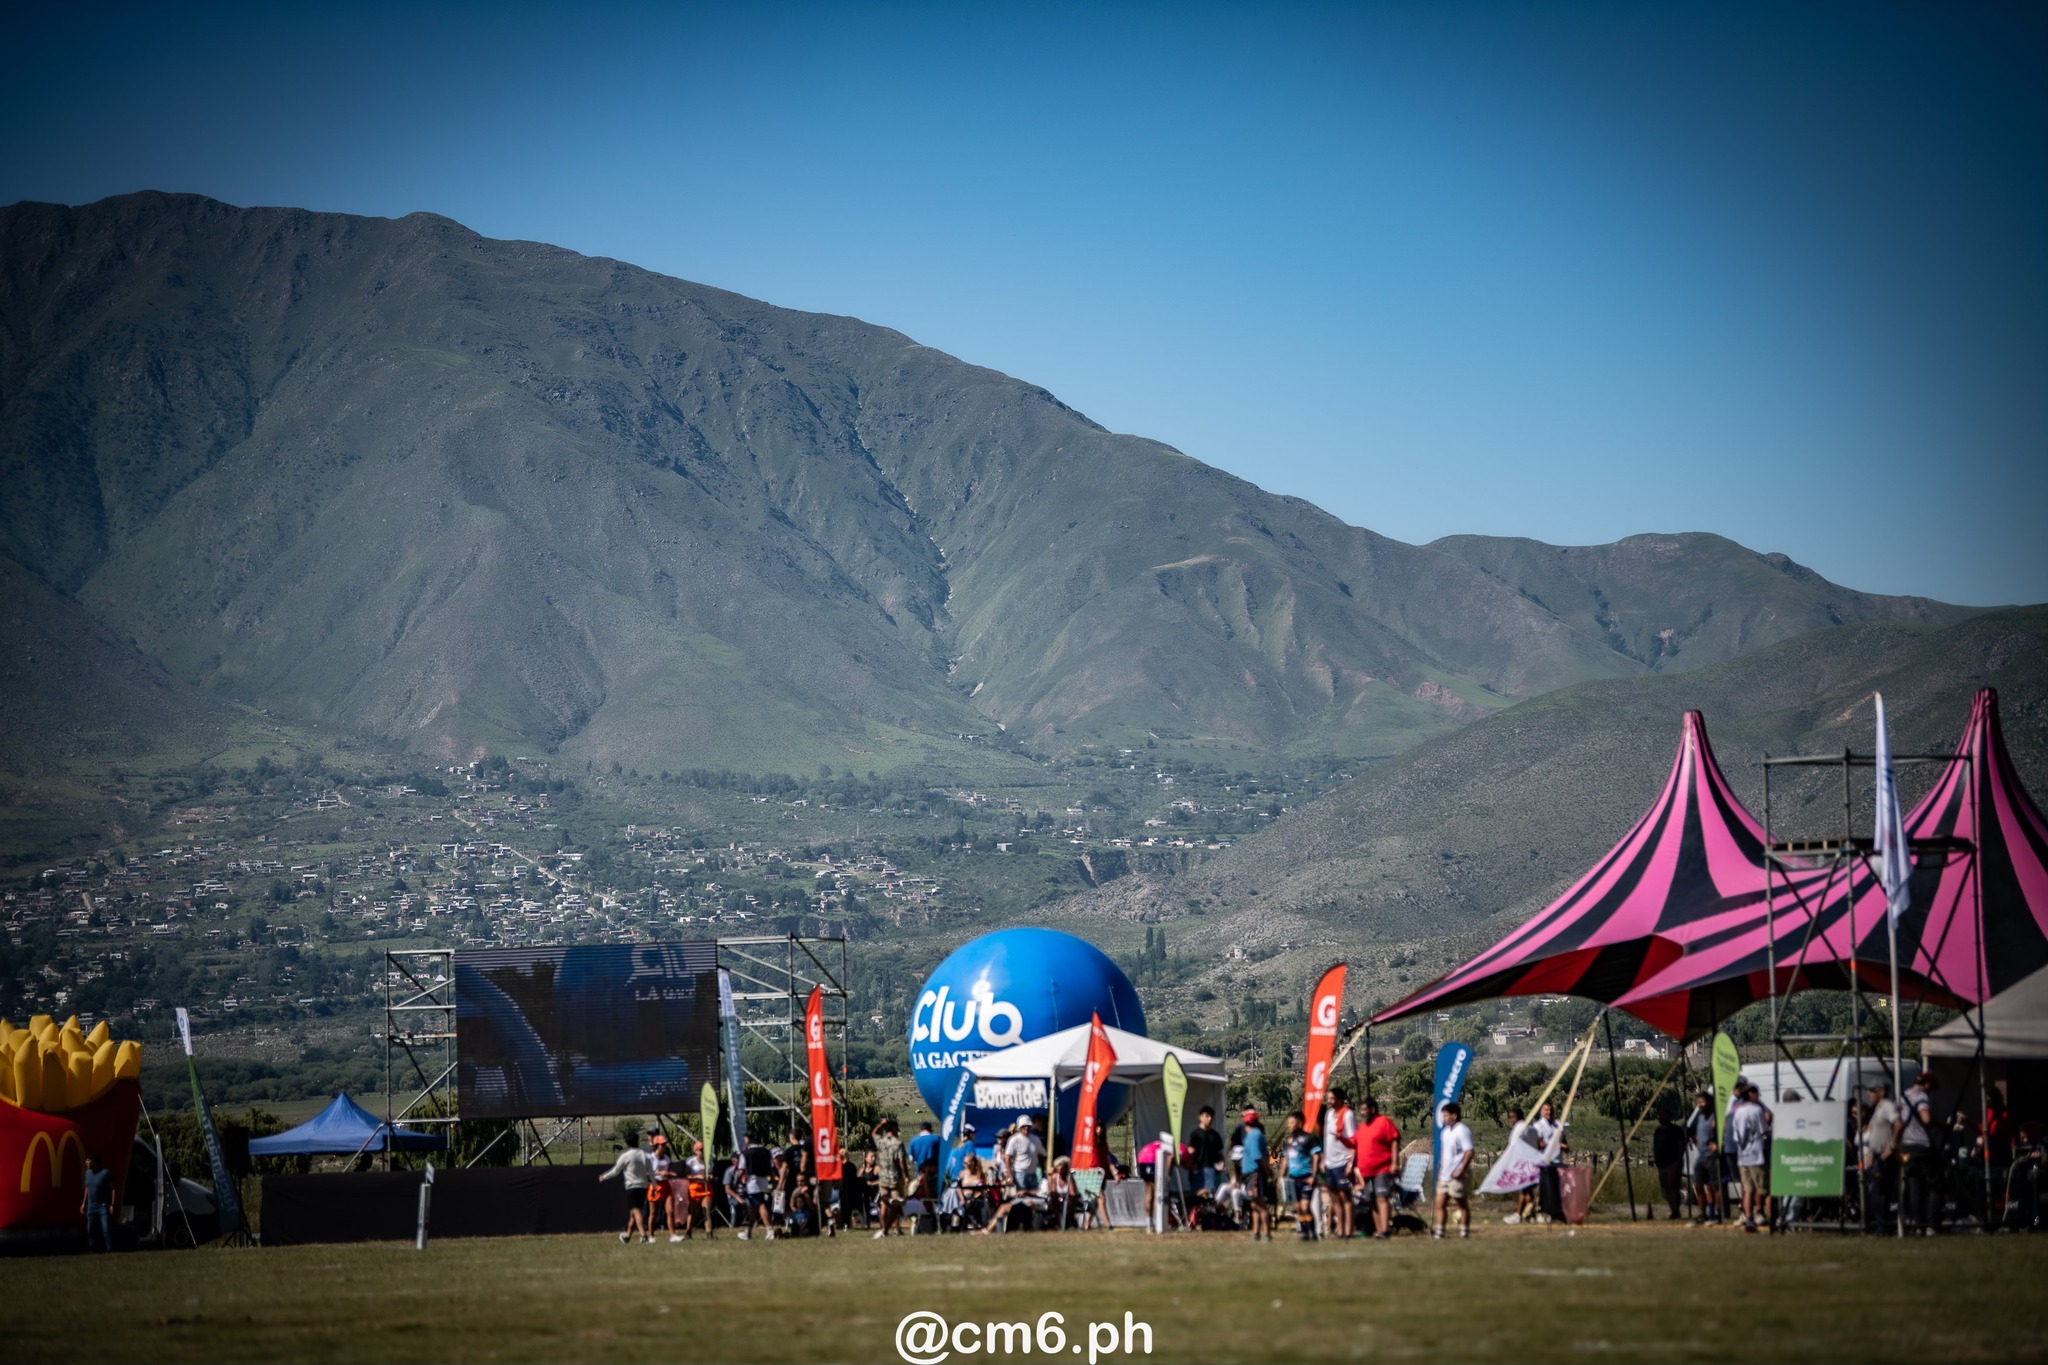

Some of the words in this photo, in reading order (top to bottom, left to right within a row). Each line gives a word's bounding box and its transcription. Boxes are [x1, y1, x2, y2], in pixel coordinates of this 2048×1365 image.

[910, 985, 1026, 1051] Club
[1317, 995, 1336, 1027] G
[928, 1050, 992, 1069] GACE
[1442, 1048, 1466, 1098] Macro
[948, 1071, 970, 1115] Macro
[817, 1127, 831, 1155] G
